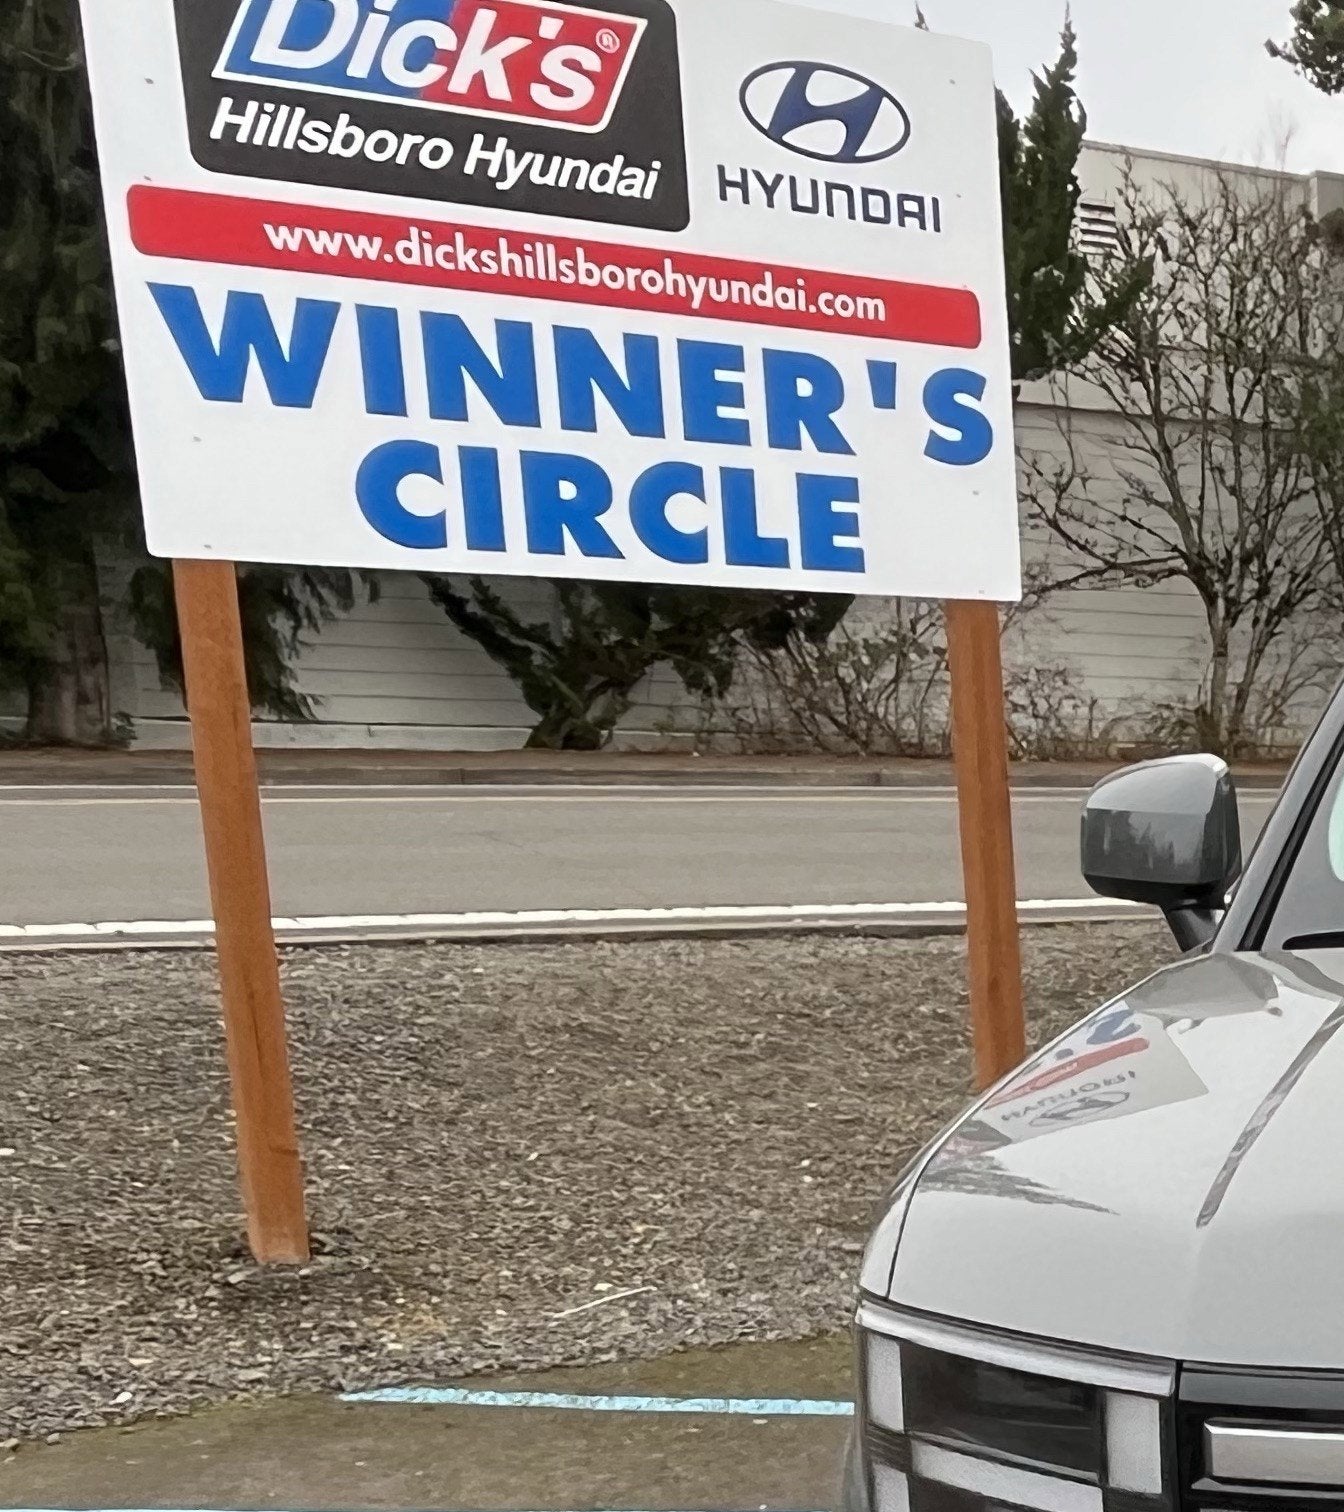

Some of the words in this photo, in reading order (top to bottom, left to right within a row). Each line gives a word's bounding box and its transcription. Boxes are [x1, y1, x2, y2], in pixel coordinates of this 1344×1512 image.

[209, 96, 454, 170] Hillsboro
[463, 133, 662, 200] Hyundai
[717, 163, 942, 234] HYUNDAI
[264, 218, 886, 323] www.dickshillsborohyundai.com
[147, 281, 994, 467] WINNER'S
[355, 438, 866, 574] CIRCLE
